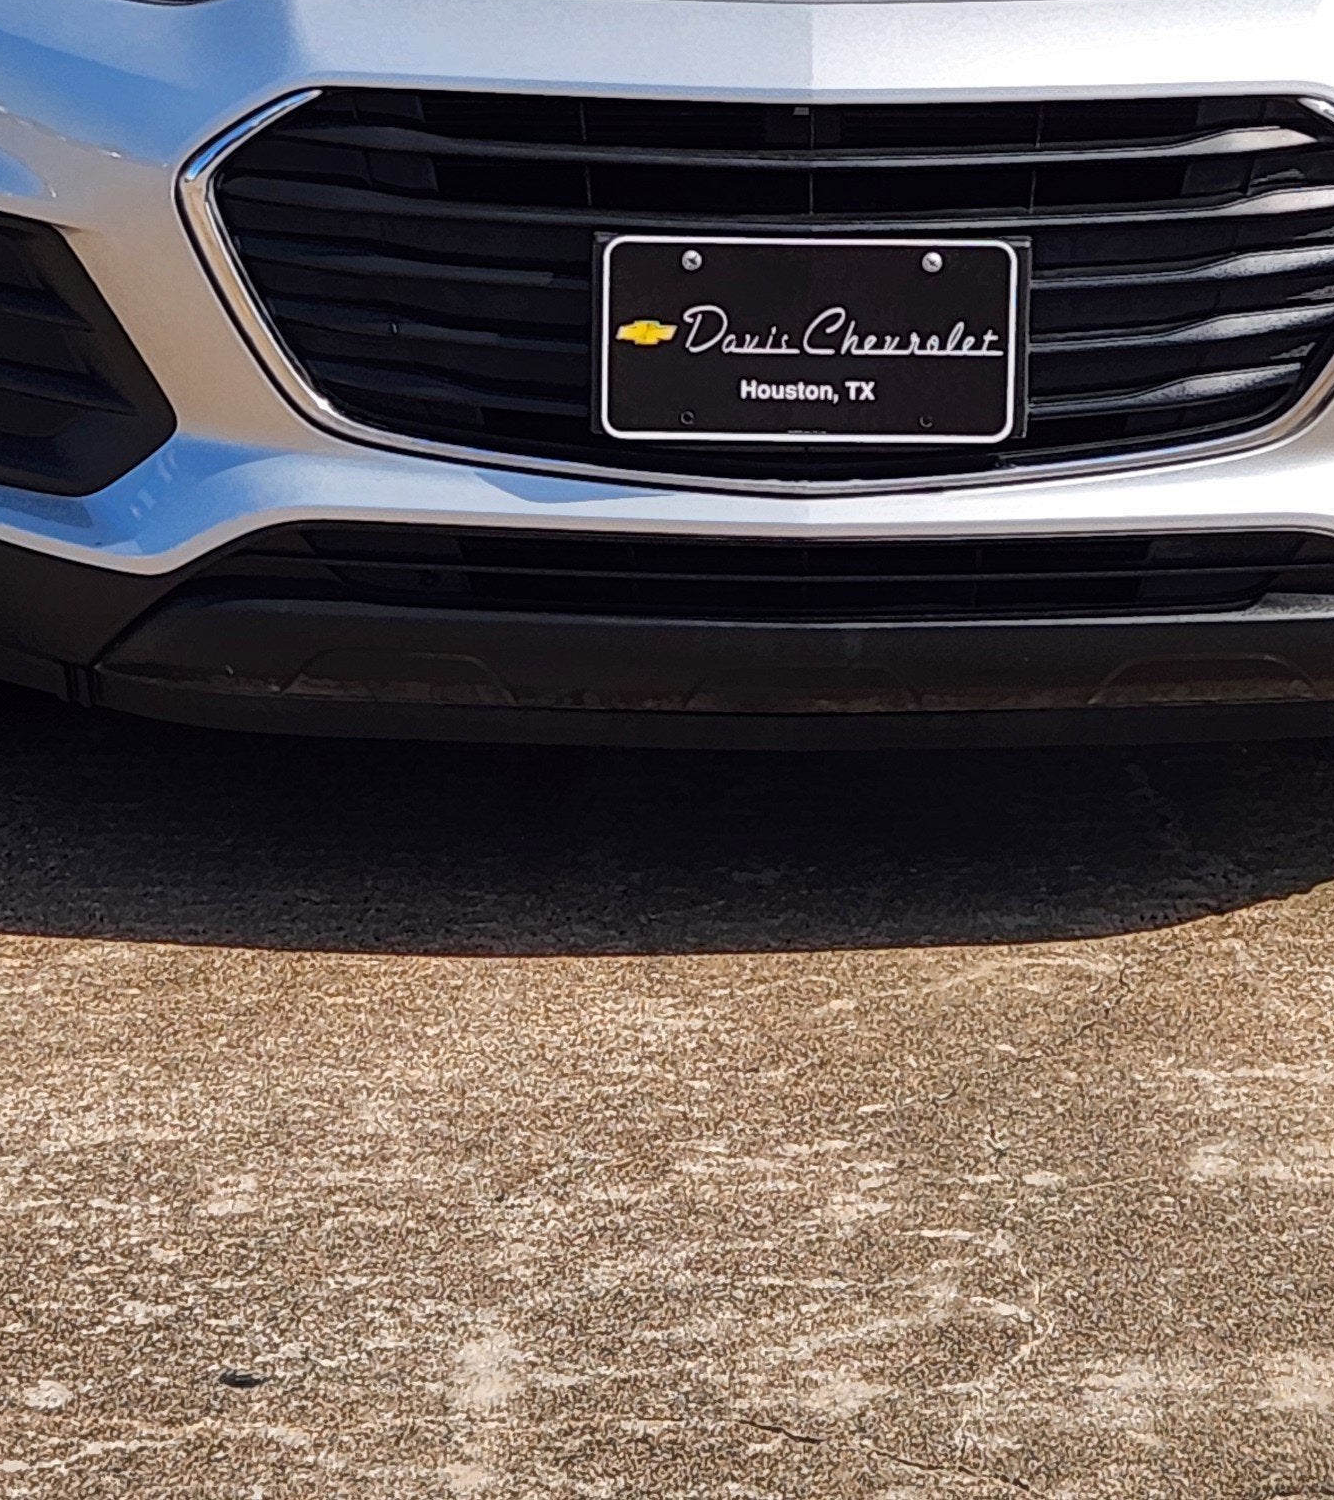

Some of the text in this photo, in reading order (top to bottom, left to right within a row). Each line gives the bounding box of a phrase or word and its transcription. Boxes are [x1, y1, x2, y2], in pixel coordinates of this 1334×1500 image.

[683, 305, 1003, 356] Davis Chevrolet
[740, 380, 875, 403] Houston, TX
